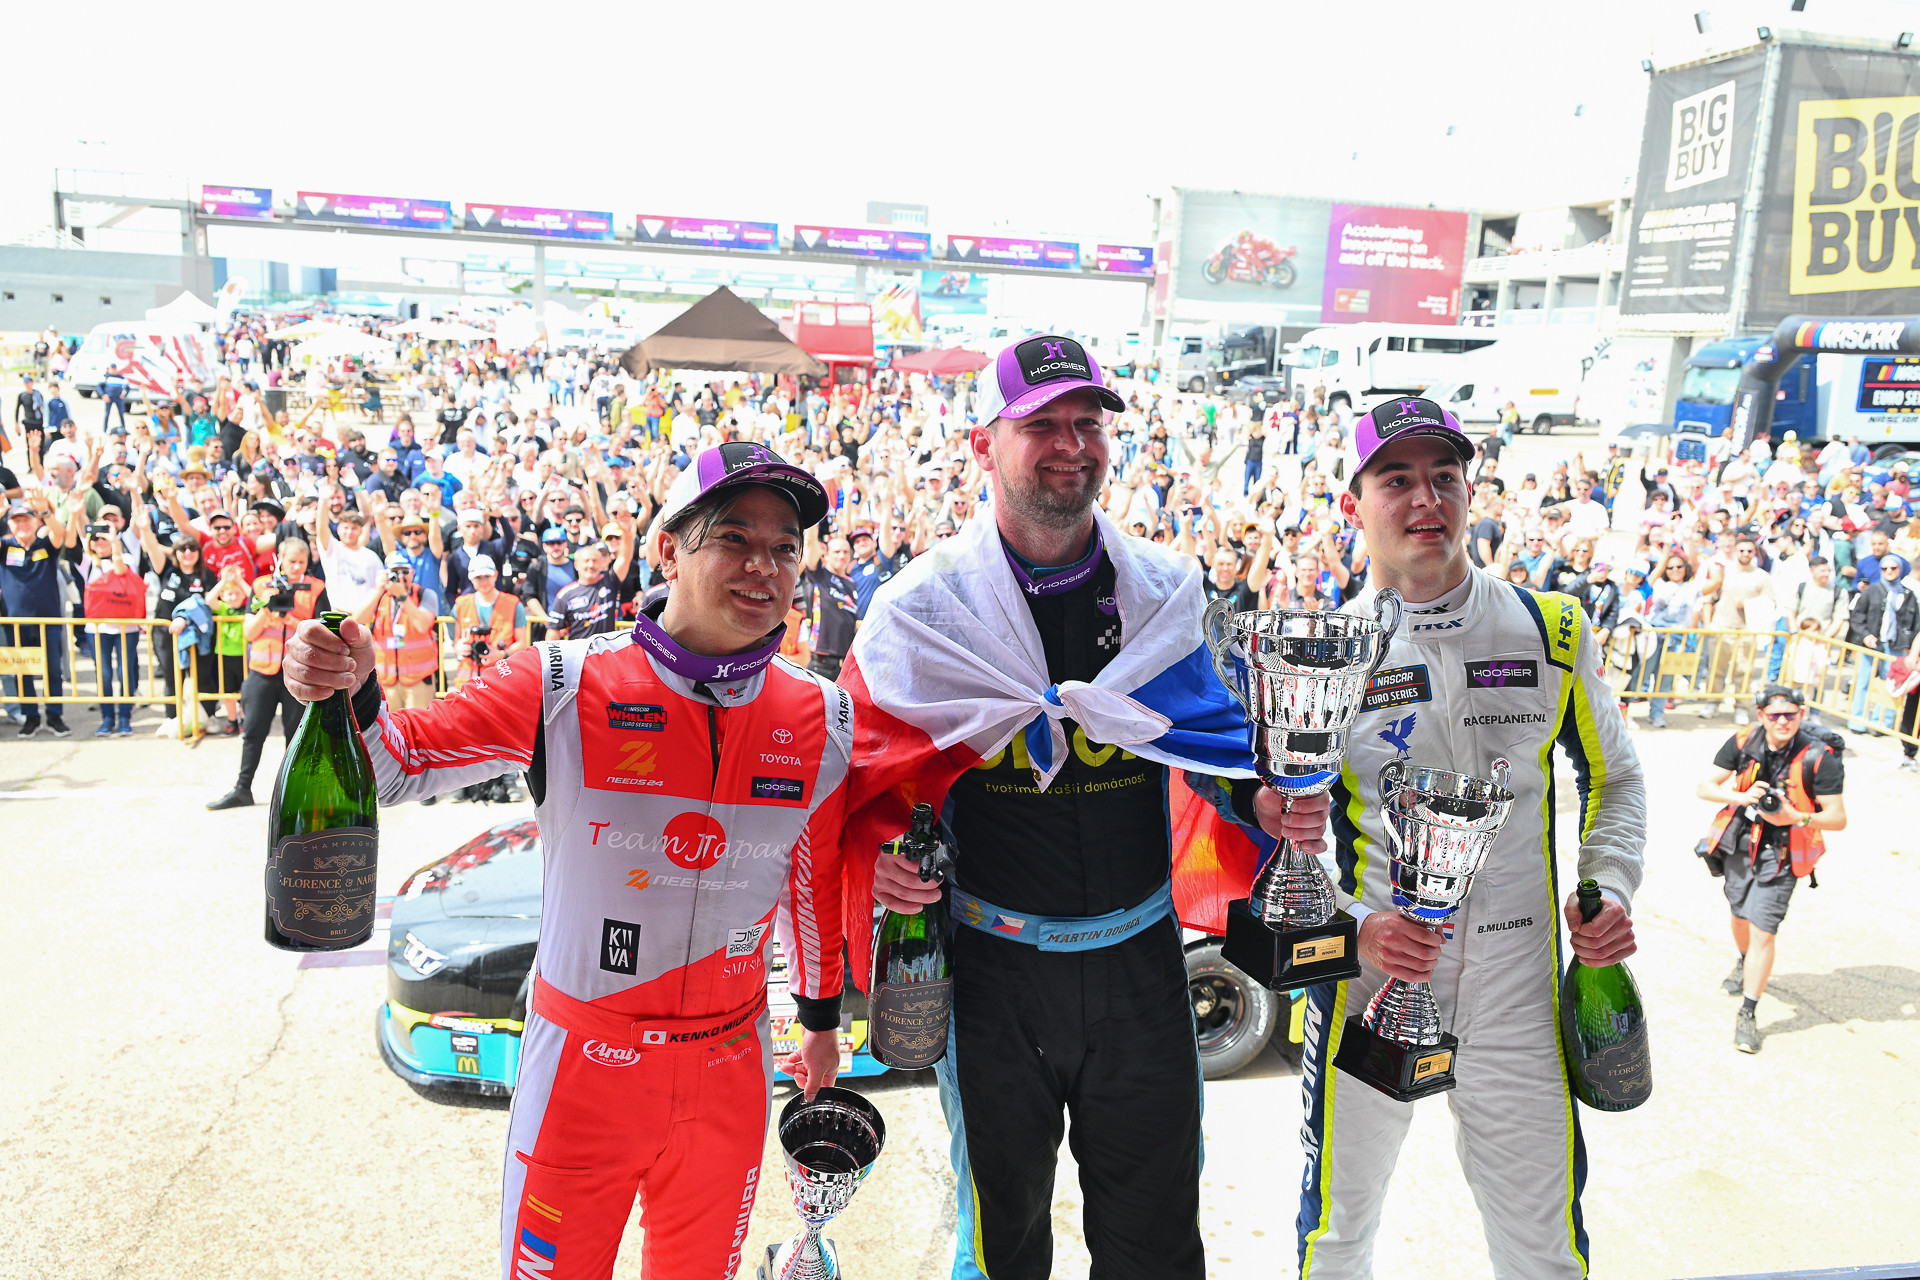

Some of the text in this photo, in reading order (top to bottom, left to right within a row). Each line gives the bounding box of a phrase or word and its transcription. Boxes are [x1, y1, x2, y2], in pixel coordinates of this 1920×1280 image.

[1675, 138, 1724, 181] BUY
[1339, 252, 1365, 265] and
[1366, 252, 1386, 266] off
[1387, 254, 1408, 268] the
[1819, 322, 1905, 350] NASCAR
[1030, 362, 1087, 377] HOOSIER
[1382, 416, 1440, 432] HOOSIER
[1042, 567, 1090, 589] HOOSIER
[1557, 600, 1574, 651] HRX
[639, 627, 677, 662] HOOSIER
[732, 651, 774, 673] HOOSIER
[1376, 671, 1414, 688] NASCAR
[1472, 668, 1532, 678] HOOSIER
[1367, 687, 1418, 706] EURO SERIES
[607, 707, 667, 724] WHELEN
[1463, 713, 1547, 727] RACEPLANET.NL
[759, 753, 802, 766] TOYOTA
[756, 783, 800, 793] HOOSIER
[588, 821, 688, 853] Team
[282, 876, 342, 889] FLORENCE
[344, 878, 353, 888] &
[330, 928, 348, 936] BRUT
[1047, 914, 1143, 944] MARTIN DOUBEK
[1477, 917, 1534, 934] B.MULDERS
[880, 1011, 924, 1026] FLORENCE
[668, 1026, 720, 1043] KENKO
[585, 1042, 634, 1060] Arai
[732, 1165, 759, 1247] MIURA
